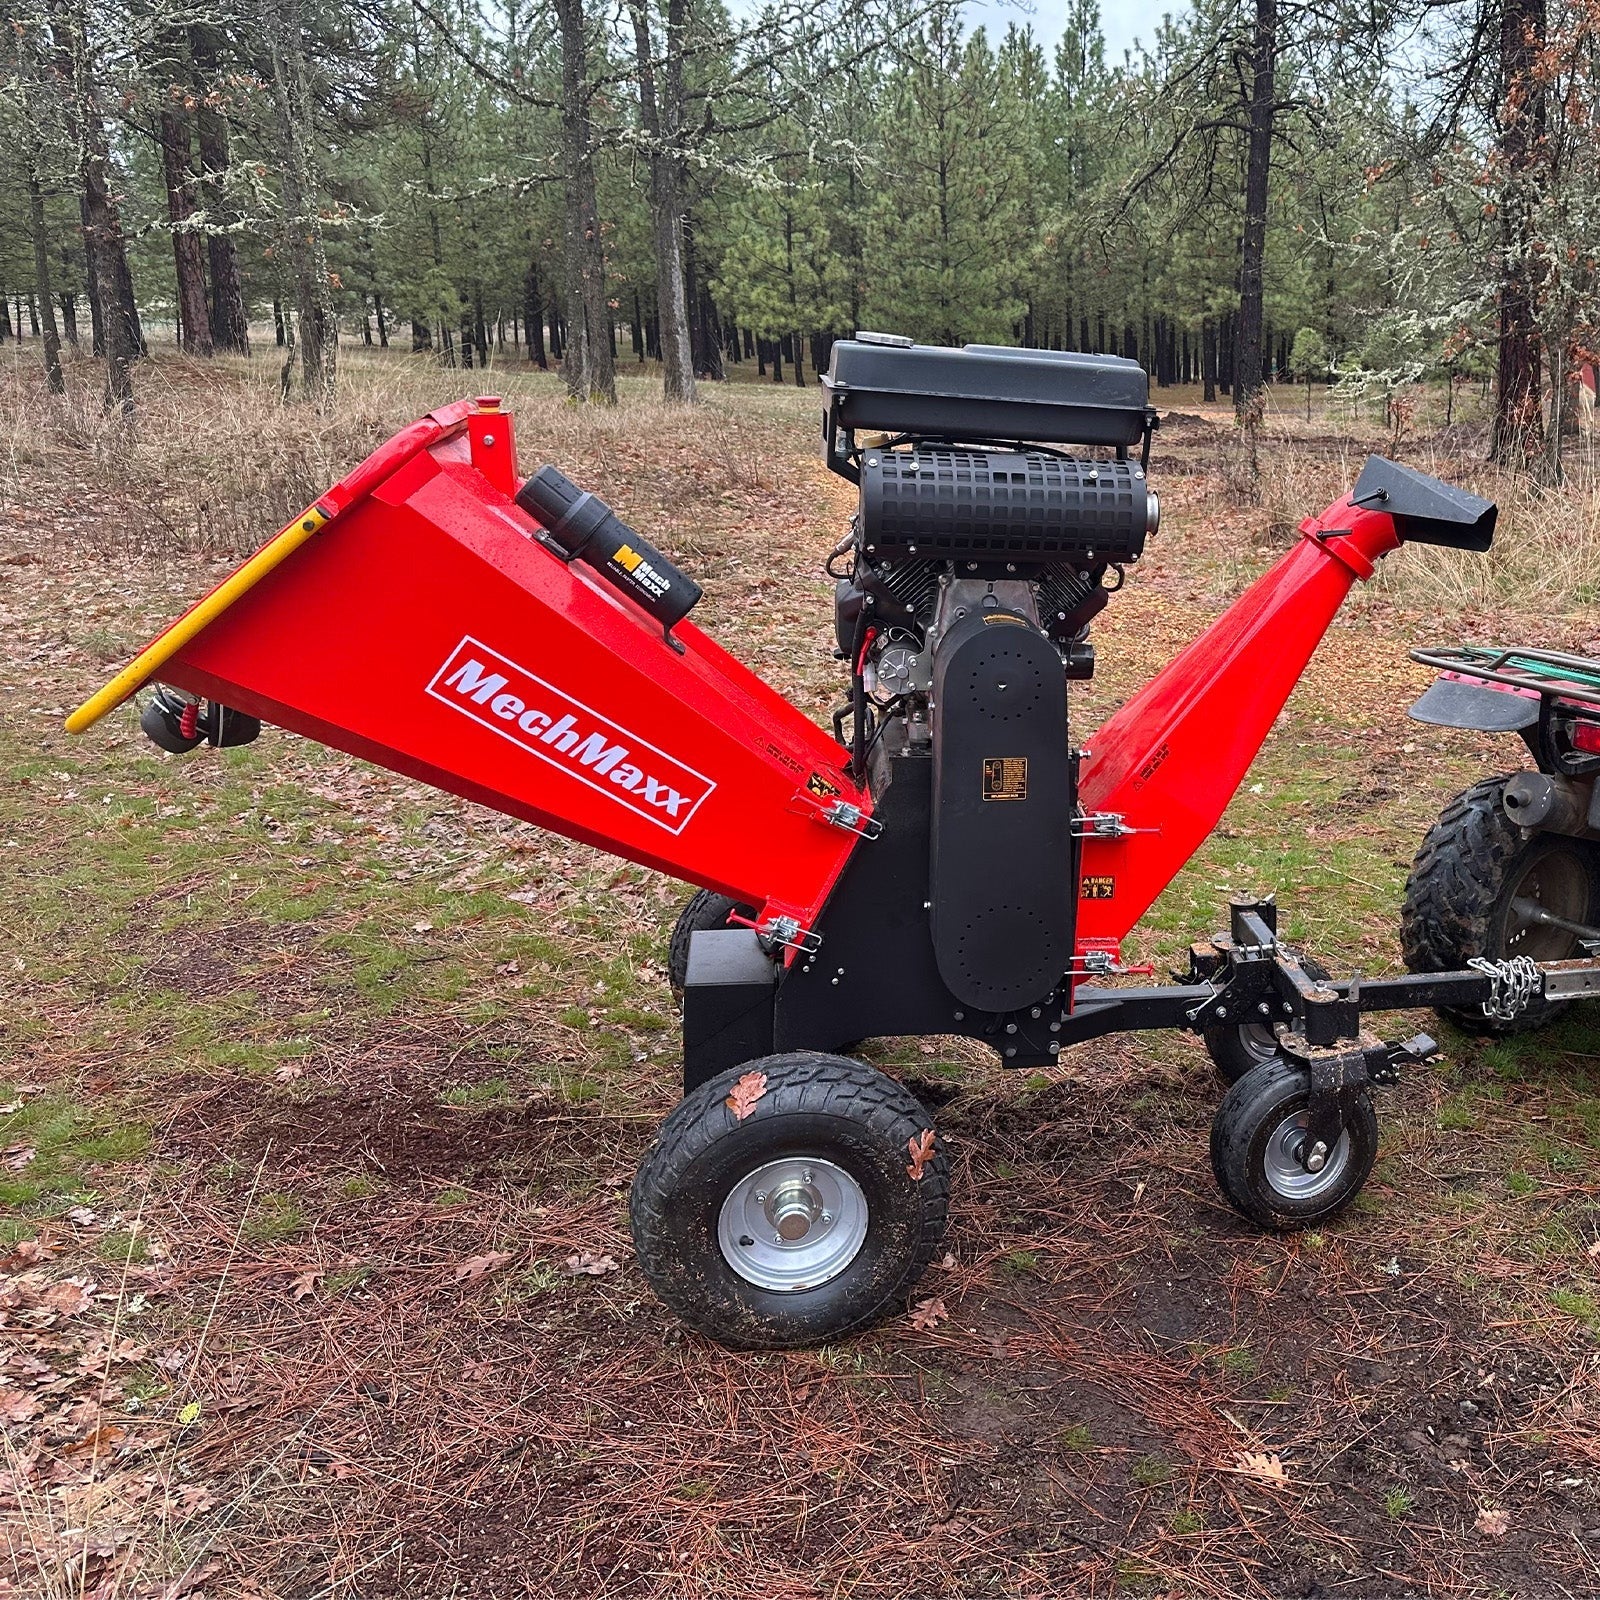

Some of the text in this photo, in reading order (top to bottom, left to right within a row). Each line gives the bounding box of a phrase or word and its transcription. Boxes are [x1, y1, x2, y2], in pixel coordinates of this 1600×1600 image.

[631, 568, 665, 598] Maxx
[638, 561, 671, 591] Mech
[444, 658, 692, 817] MechMaxx
[1090, 877, 1113, 885] DANGER
